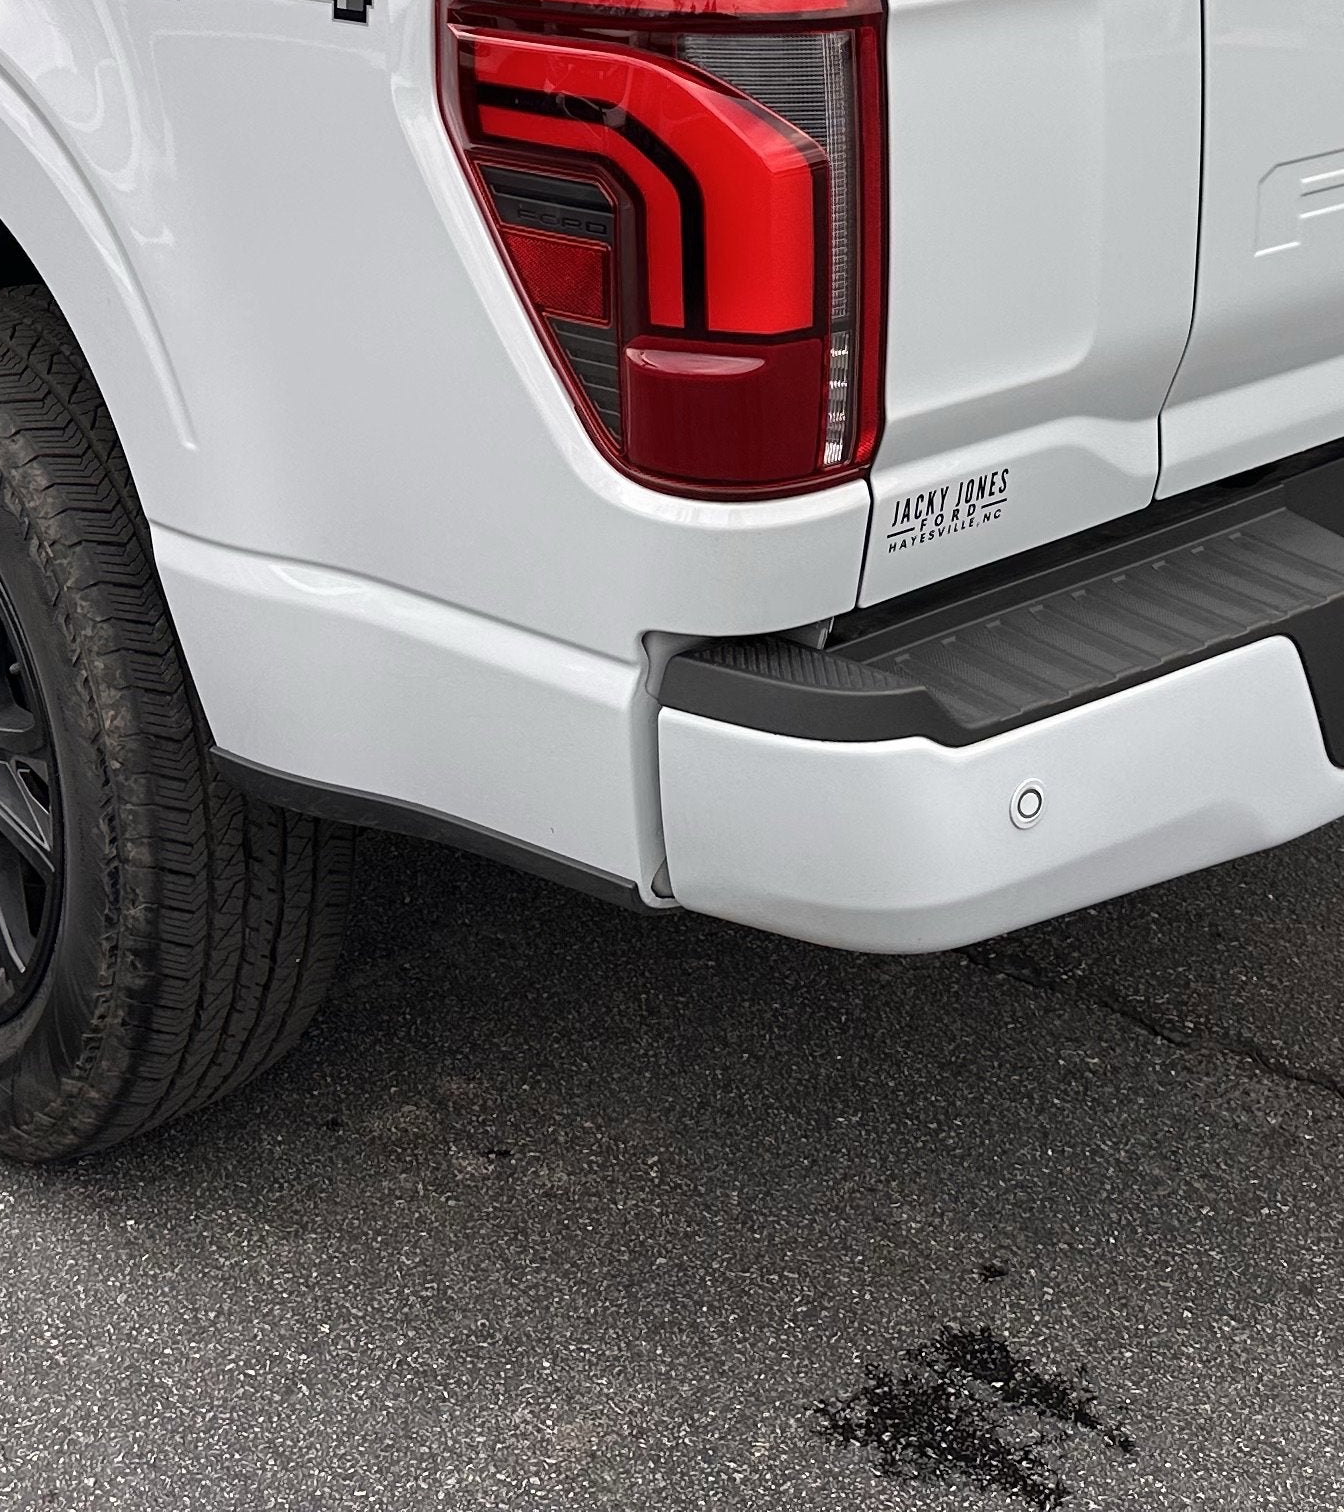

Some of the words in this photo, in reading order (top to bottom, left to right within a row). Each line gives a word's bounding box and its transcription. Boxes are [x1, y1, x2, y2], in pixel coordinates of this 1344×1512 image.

[516, 206, 610, 236] FORD
[892, 486, 950, 527] JACKY
[955, 468, 1009, 507] JONES
[919, 503, 976, 532] FORD
[982, 508, 1002, 524] NC
